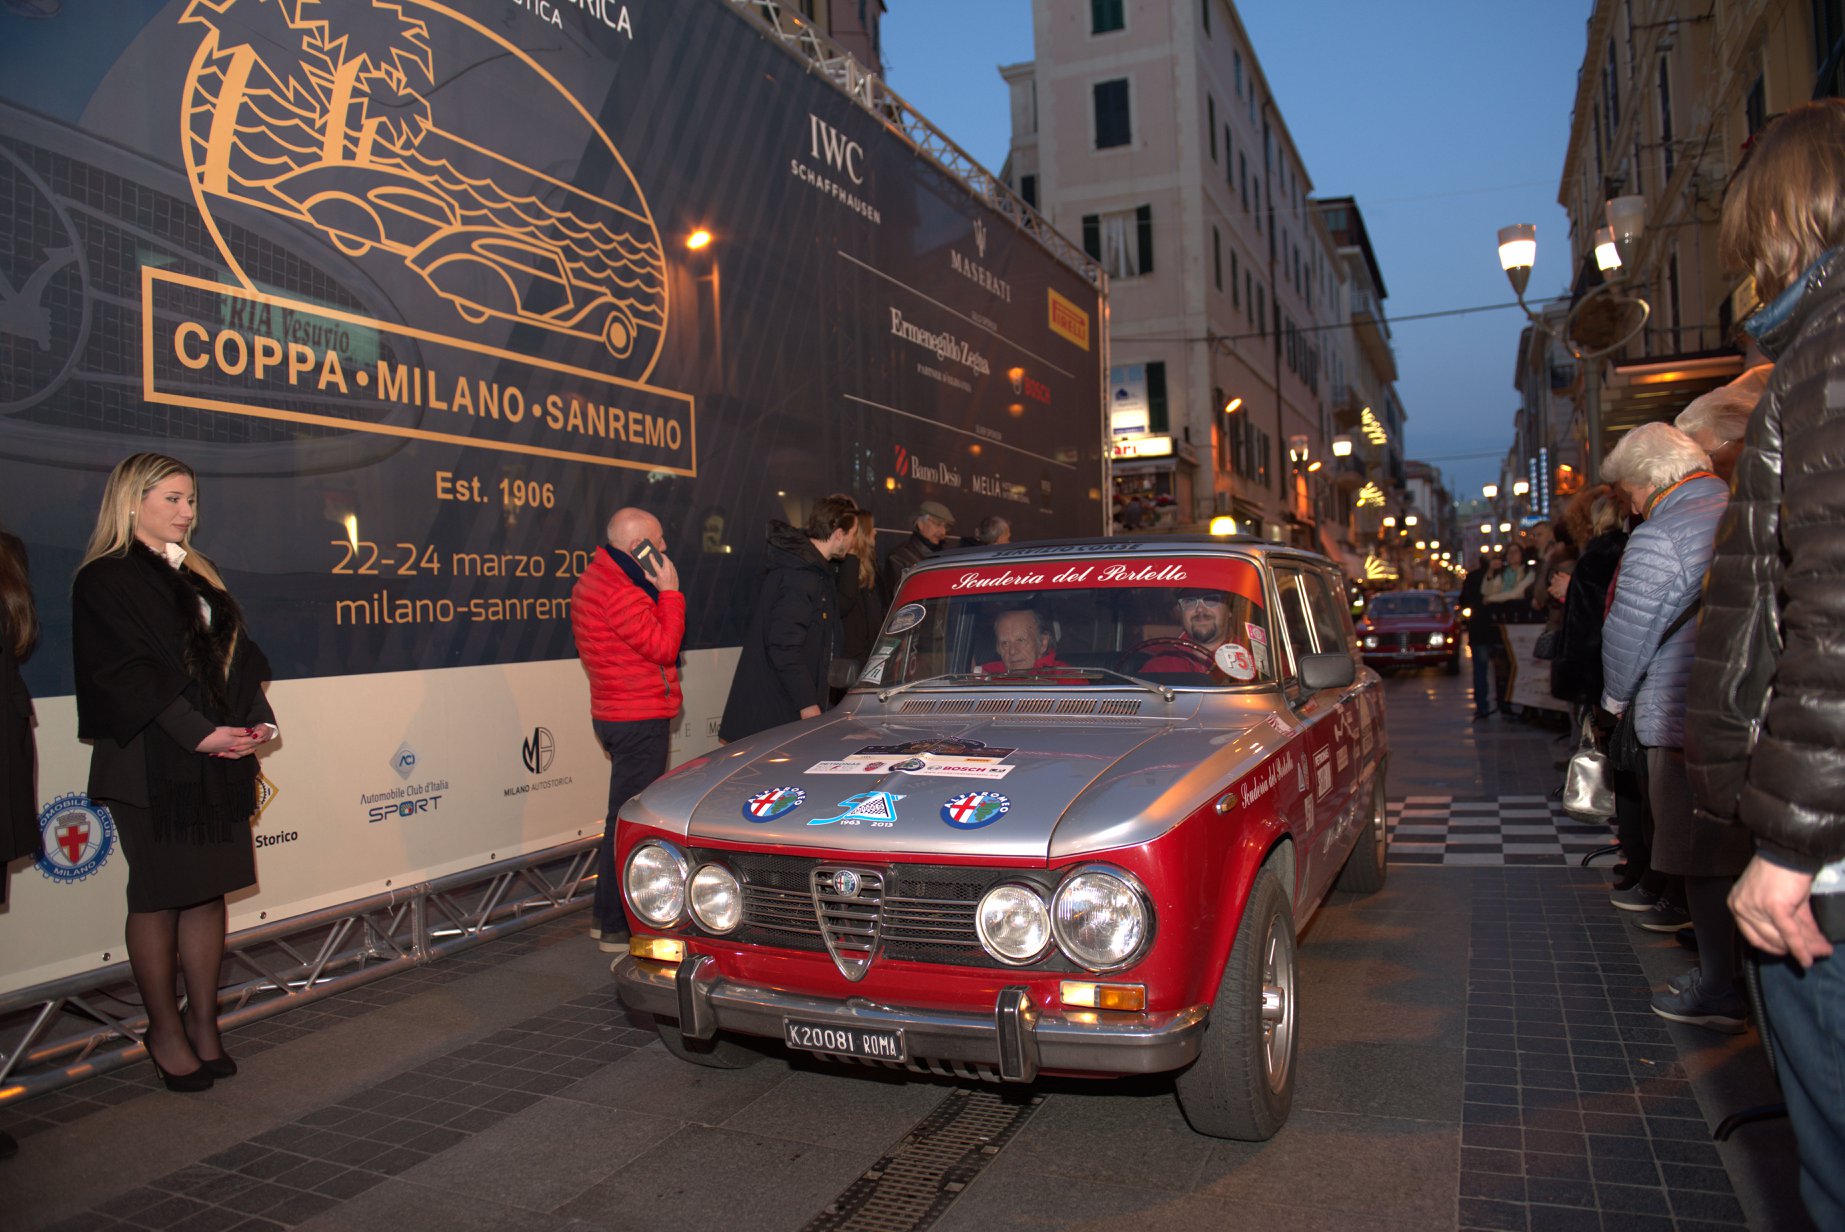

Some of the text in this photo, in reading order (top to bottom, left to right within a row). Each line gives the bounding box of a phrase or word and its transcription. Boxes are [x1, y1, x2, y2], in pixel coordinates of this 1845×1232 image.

[809, 112, 864, 185] IWC
[790, 158, 881, 225] SCHAFFHAUSEN
[951, 249, 1011, 303] MASERATI
[1051, 299, 1086, 342] PIRELLI
[889, 306, 961, 362] Ermenegildo
[961, 341, 991, 376] Zegna
[174, 321, 682, 450] COPPA MILANO SANREMO
[911, 455, 962, 487] Banco Desio
[436, 470, 556, 509] Est. 1906
[331, 540, 441, 576] 22-24
[452, 552, 545, 577] marzo
[991, 543, 1143, 558] SERVIZIO CORSE
[951, 564, 1187, 590] Scuderia del Portello
[399, 754, 416, 768] ACI
[943, 765, 987, 773] BOSCH
[1268, 762, 1277, 788] del
[360, 779, 449, 806] Automobile Club d'Italia
[503, 776, 573, 797] MILANO AUTOSTORICA
[40, 800, 111, 838] OMOBILE CLUB
[368, 795, 442, 823] SPORT
[255, 830, 298, 848] Storico
[53, 861, 96, 876] MILANO
[789, 1025, 897, 1056] K20081 ROMA
